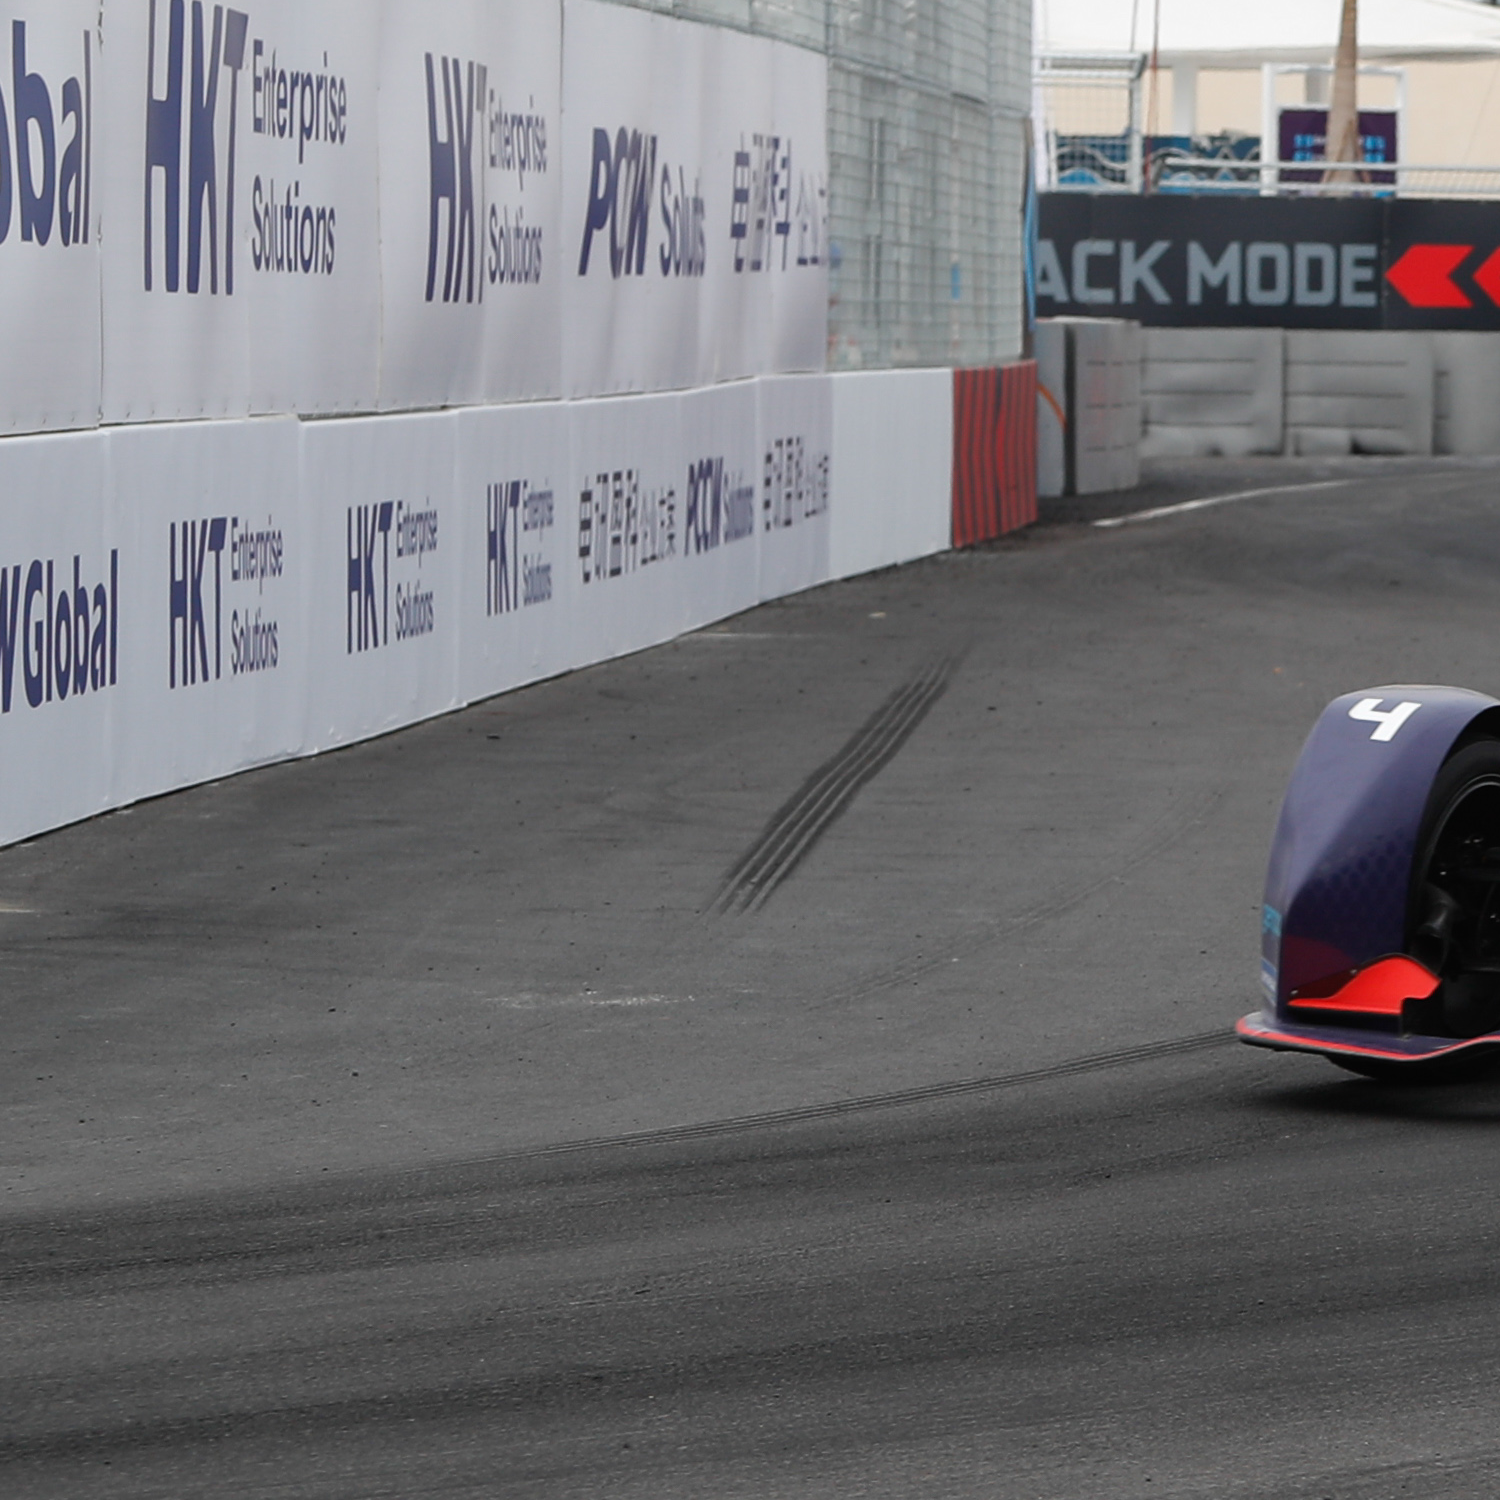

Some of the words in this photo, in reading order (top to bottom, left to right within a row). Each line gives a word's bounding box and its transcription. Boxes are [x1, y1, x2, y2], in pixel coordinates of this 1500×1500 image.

[252, 38, 348, 164] Enterprise
[488, 88, 547, 192] Enterprise
[251, 175, 337, 276] Solutions
[488, 202, 543, 287] Solutions
[1187, 243, 1379, 307] MODE
[347, 500, 394, 655] HKT
[397, 500, 438, 569] Enterprise
[487, 479, 521, 618] HKT
[522, 478, 555, 537] Enterprise
[169, 516, 227, 689] HKT
[231, 515, 283, 603] Enterprise
[231, 617, 279, 676] Solutions
[396, 581, 435, 644] Solutions
[1348, 698, 1422, 742] 4
